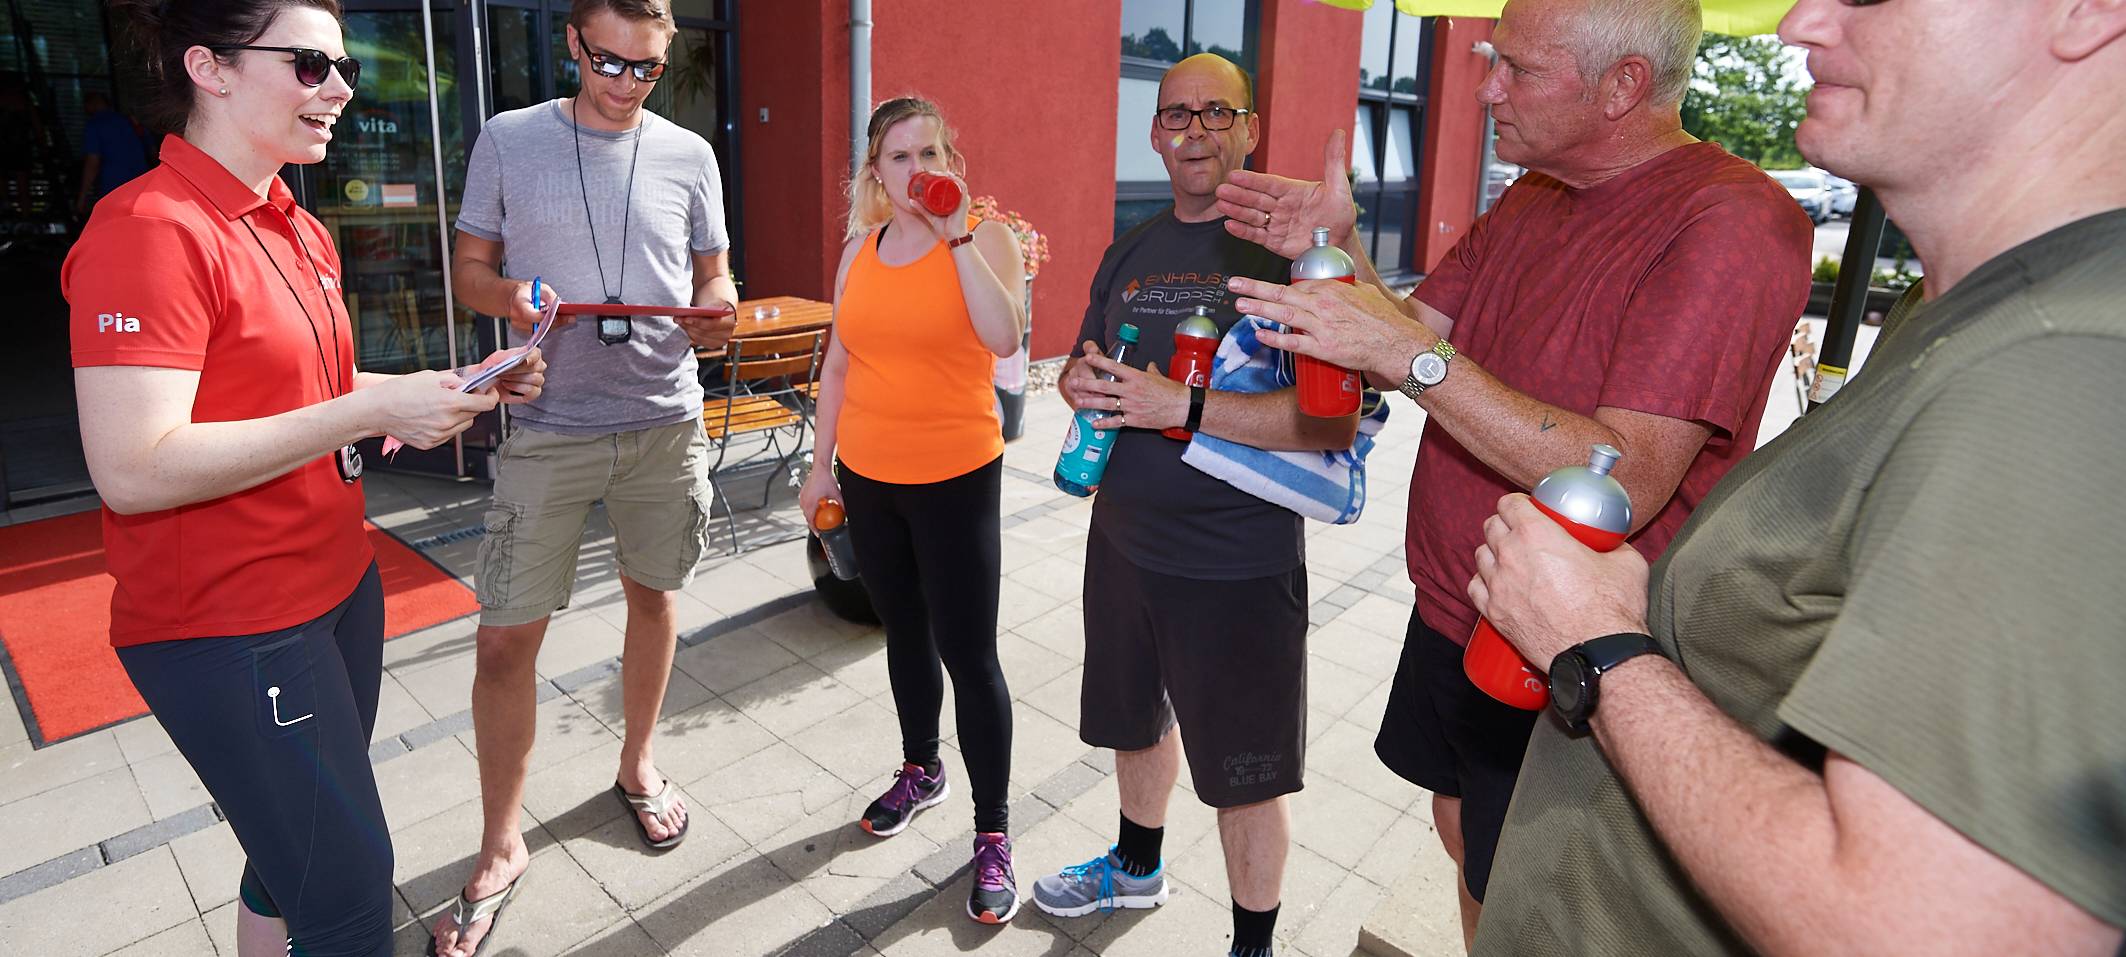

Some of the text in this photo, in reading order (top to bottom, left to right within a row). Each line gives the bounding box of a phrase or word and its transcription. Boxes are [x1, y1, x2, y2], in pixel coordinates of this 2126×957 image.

[359, 117, 397, 133] vita
[1136, 287, 1216, 303] GRUPPE
[98, 312, 141, 333] Pia
[1229, 771, 1278, 787] BLUE BAY
